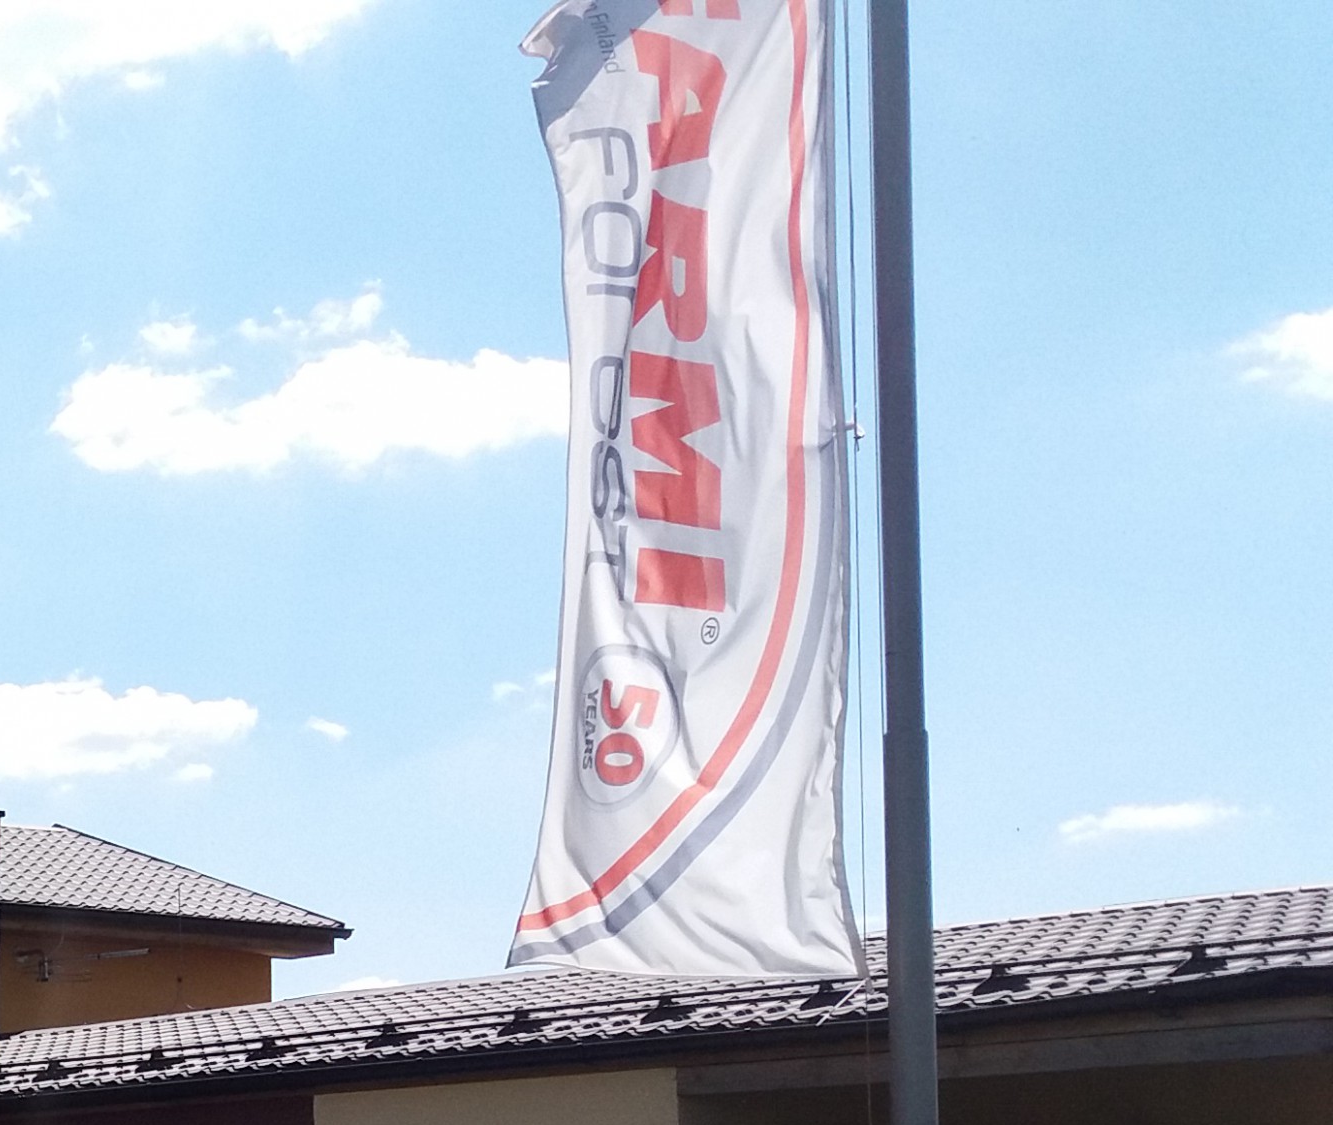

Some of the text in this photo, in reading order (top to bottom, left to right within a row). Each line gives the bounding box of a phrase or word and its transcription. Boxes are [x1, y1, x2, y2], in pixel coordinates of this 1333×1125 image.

[586, 12, 626, 74] Finland
[630, 0, 741, 612] ARMI
[580, 687, 599, 771] YEARS
[595, 677, 660, 786] 50
